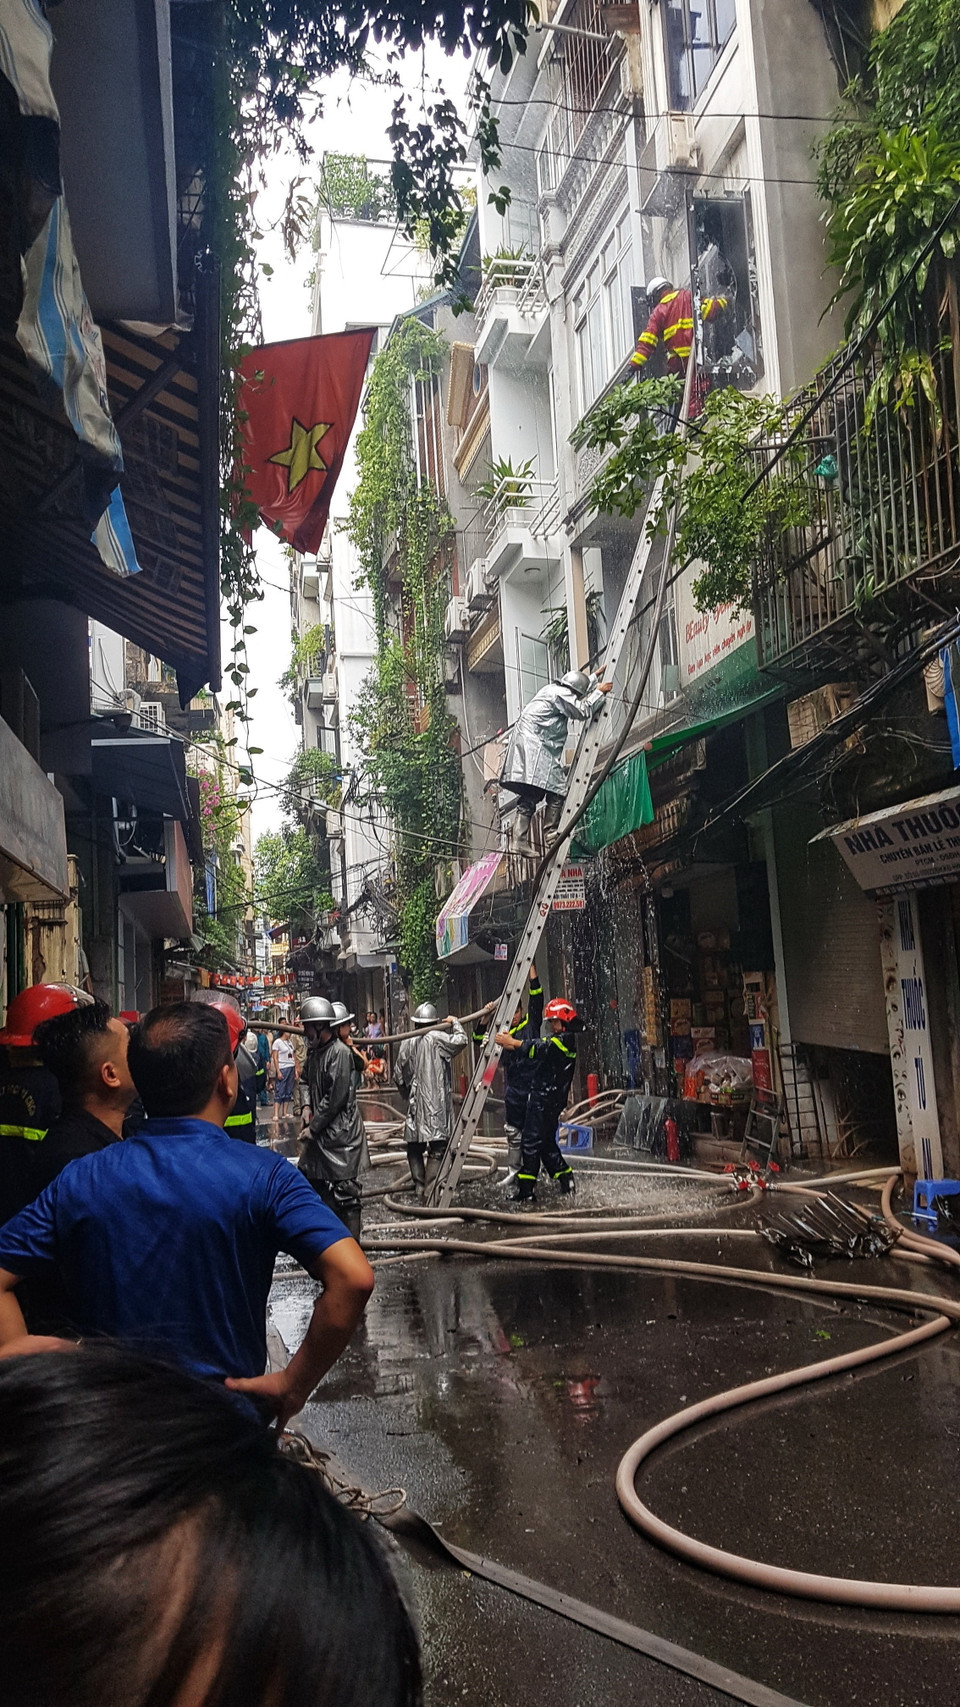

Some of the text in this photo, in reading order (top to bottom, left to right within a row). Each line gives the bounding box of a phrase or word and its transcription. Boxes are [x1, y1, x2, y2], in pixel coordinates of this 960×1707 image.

[844, 823, 894, 855] NHÀ
[880, 847, 914, 864] CHUYÊN
[901, 958, 925, 1030] THUỐC
